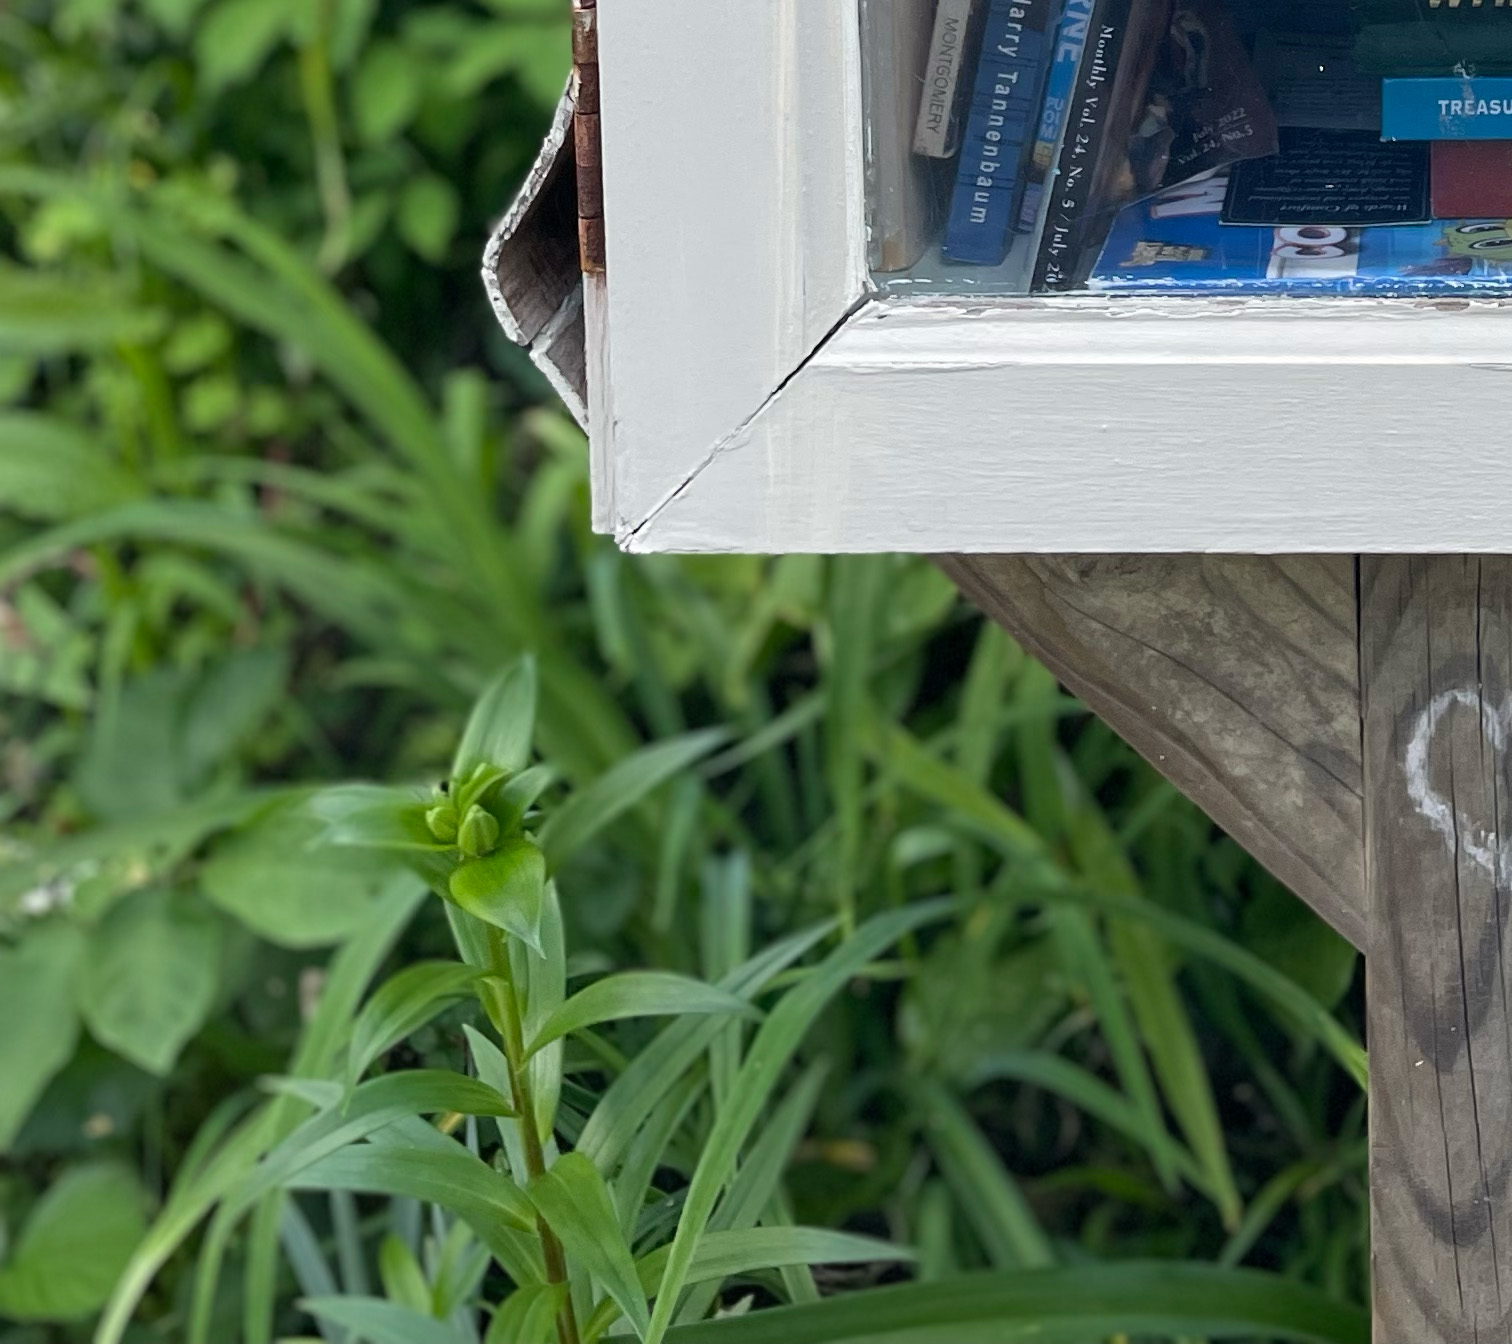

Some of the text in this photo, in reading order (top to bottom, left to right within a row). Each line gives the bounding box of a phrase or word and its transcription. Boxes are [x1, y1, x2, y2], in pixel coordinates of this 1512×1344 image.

[1085, 23, 1115, 89] Monthly
[923, 15, 960, 136] MONTGOMERY
[1078, 95, 1099, 128] Vol.
[969, 69, 1018, 225] Tannenbaum
[1071, 134, 1090, 160] 24,
[1064, 164, 1084, 193] No.
[1061, 198, 1076, 209] 5
[1047, 224, 1070, 258] July
